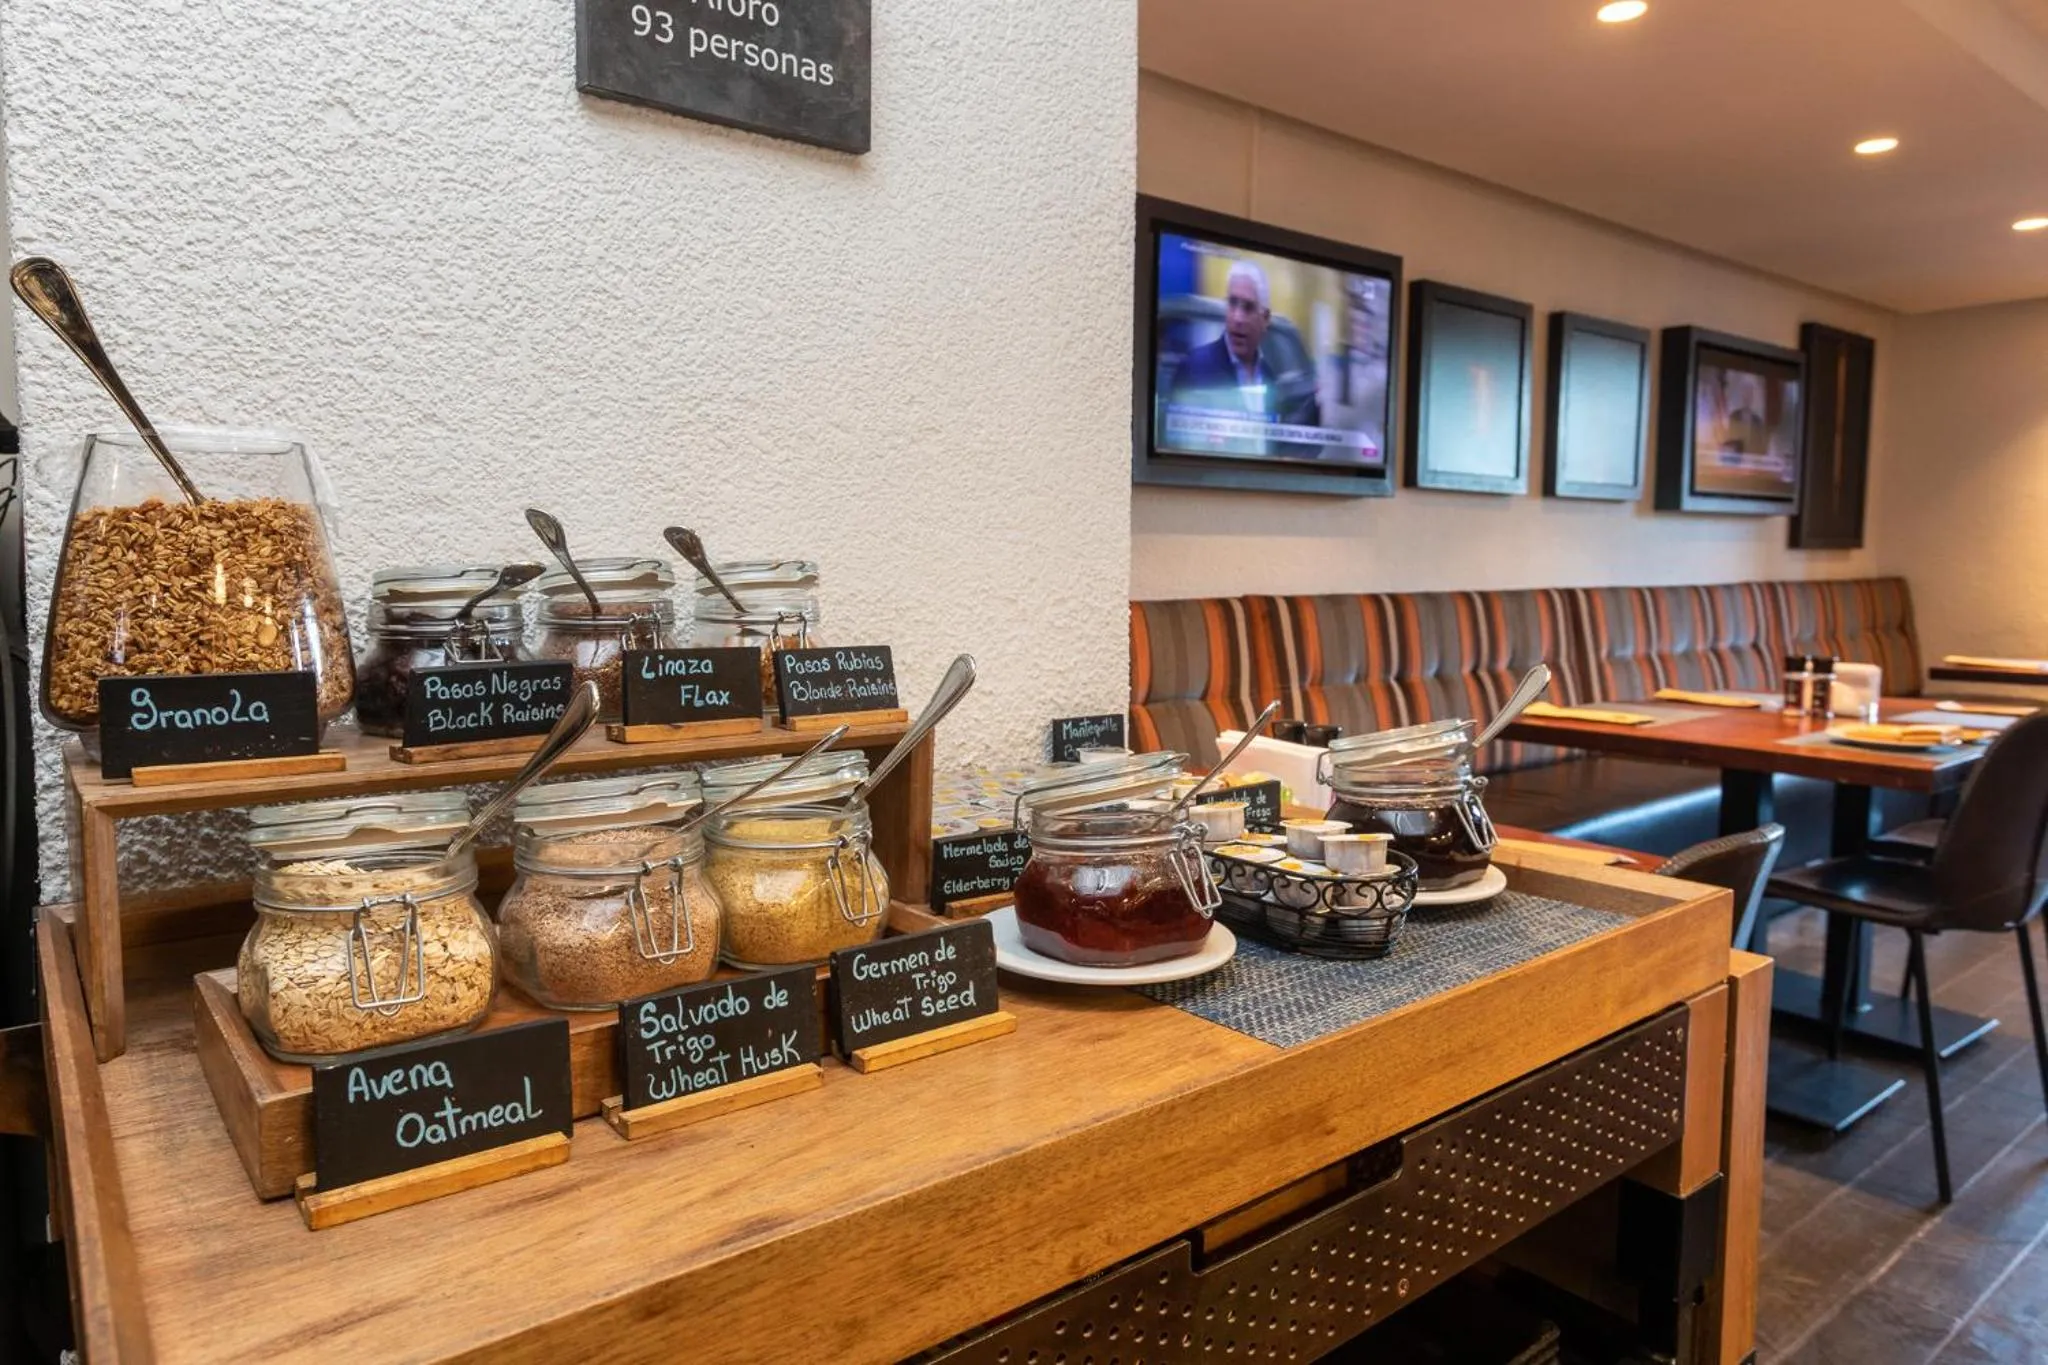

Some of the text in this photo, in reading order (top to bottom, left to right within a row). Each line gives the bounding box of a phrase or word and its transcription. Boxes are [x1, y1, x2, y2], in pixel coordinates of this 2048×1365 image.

[691, 0, 780, 27] oro
[631, 5, 834, 86] 93 personas
[641, 655, 714, 680] Linaza
[785, 651, 884, 674] Pasas Rubias
[424, 671, 562, 701] Pasas Negras
[789, 677, 897, 703] Blonde Raisins
[502, 702, 565, 724] Raisins
[942, 834, 1029, 859] Mermelada de
[943, 876, 1010, 895] Elderberry
[852, 936, 957, 980] Germen de
[911, 970, 957, 994] Trigo
[639, 979, 789, 1039] Salvado de
[920, 980, 977, 1017] Seed
[646, 1033, 716, 1065] Trigo
[347, 1060, 454, 1104] Avena
